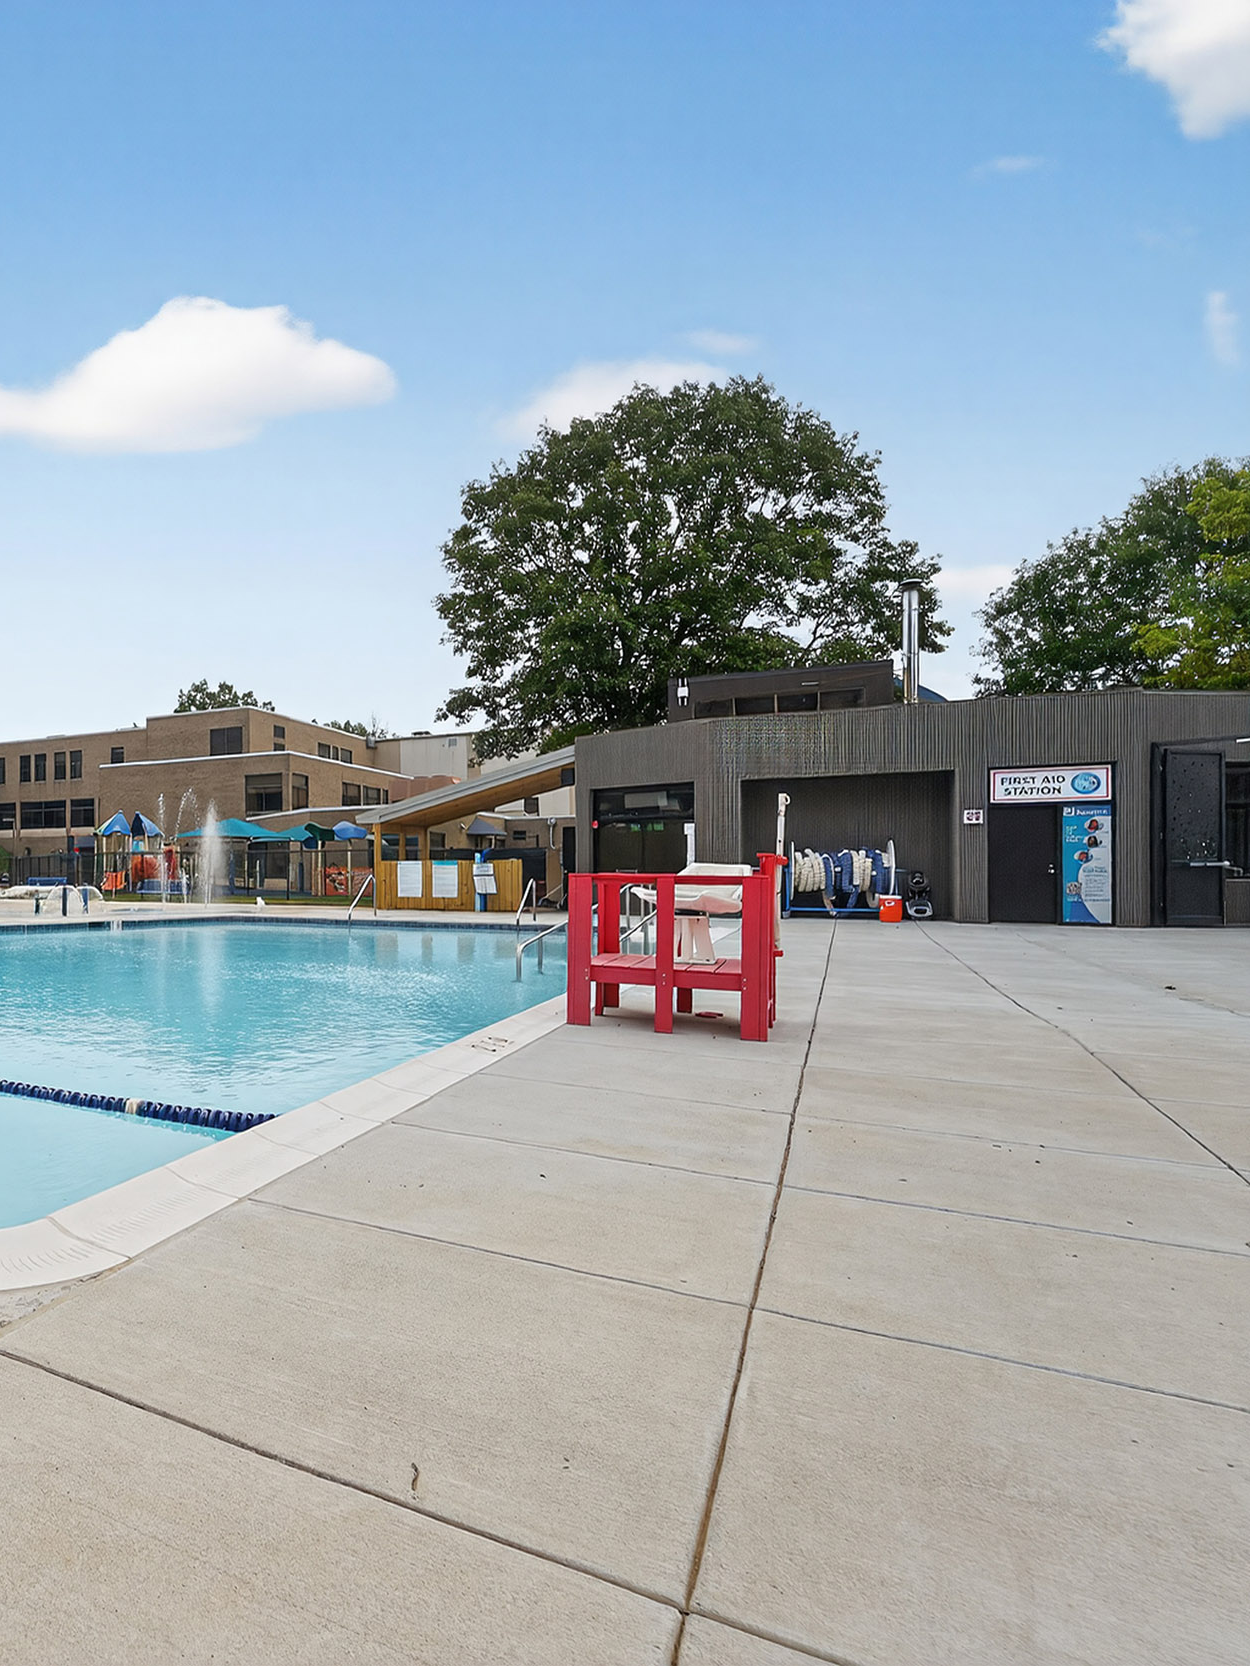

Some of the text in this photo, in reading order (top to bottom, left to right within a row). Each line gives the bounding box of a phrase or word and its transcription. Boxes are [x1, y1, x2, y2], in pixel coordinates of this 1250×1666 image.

[1000, 775, 1066, 786] FIRST AID
[1004, 786, 1062, 796] STATION
